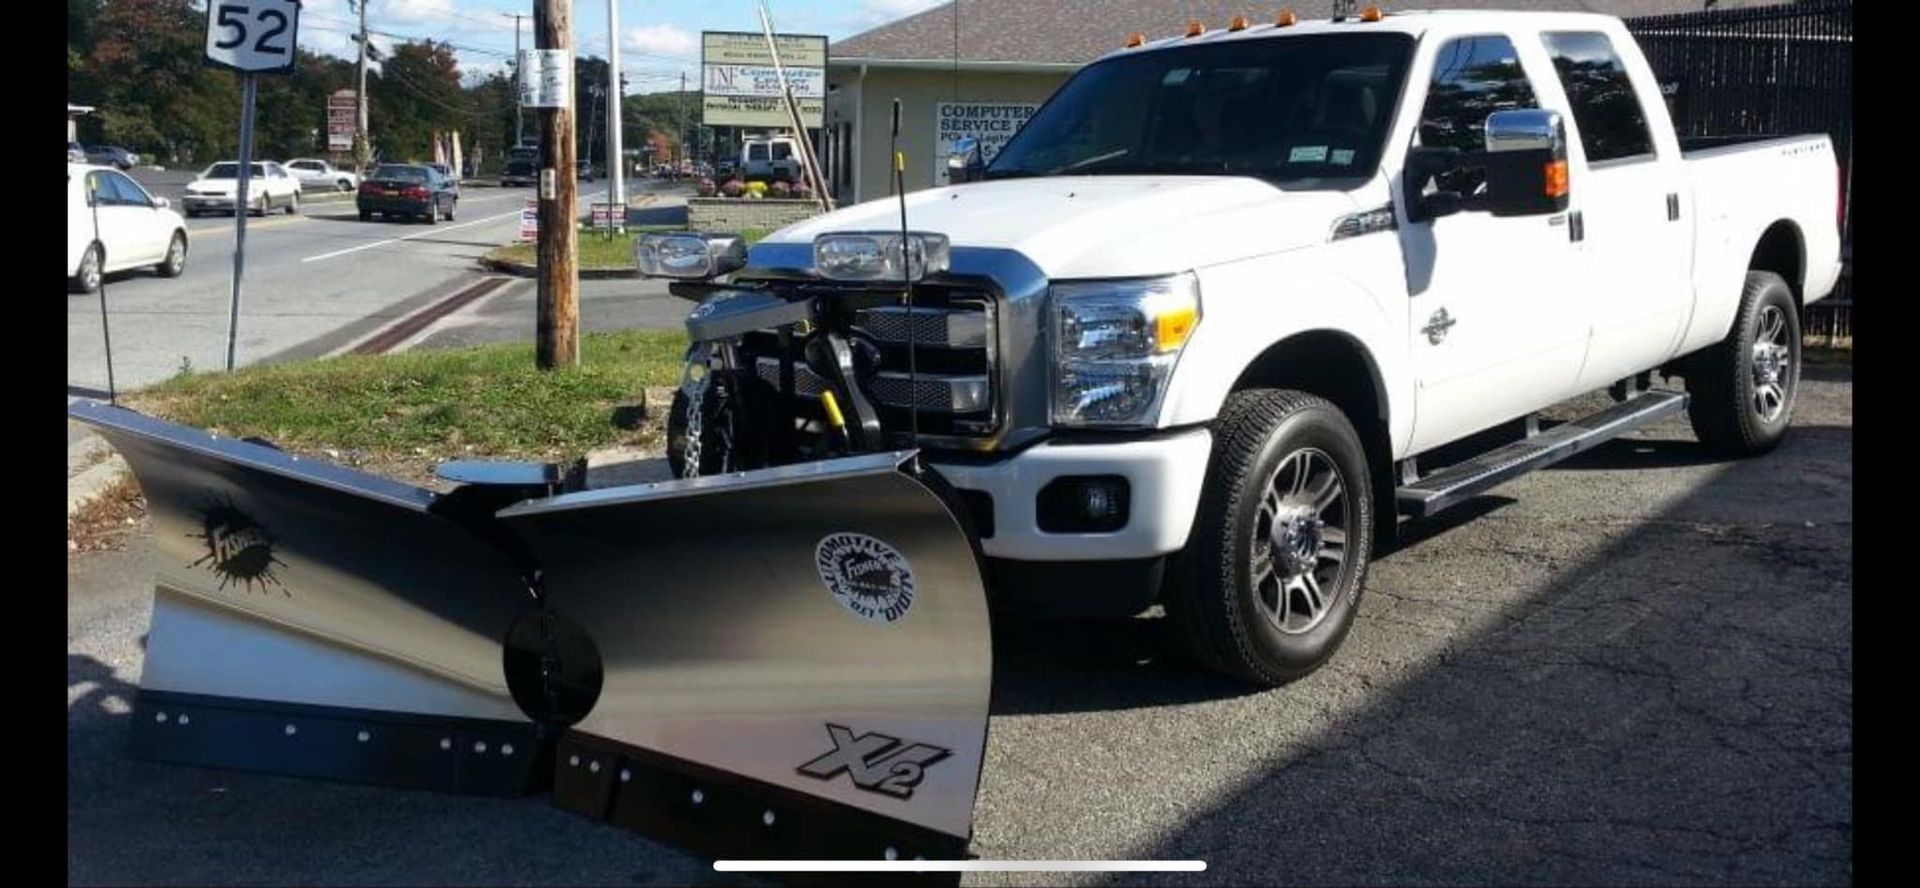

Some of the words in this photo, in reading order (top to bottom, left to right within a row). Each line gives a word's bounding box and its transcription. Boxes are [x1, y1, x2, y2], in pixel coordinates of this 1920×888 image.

[215, 5, 288, 54] 52
[940, 119, 1011, 131] SERVICE
[941, 104, 1035, 118] COMPUTER
[796, 722, 954, 801] XV2
